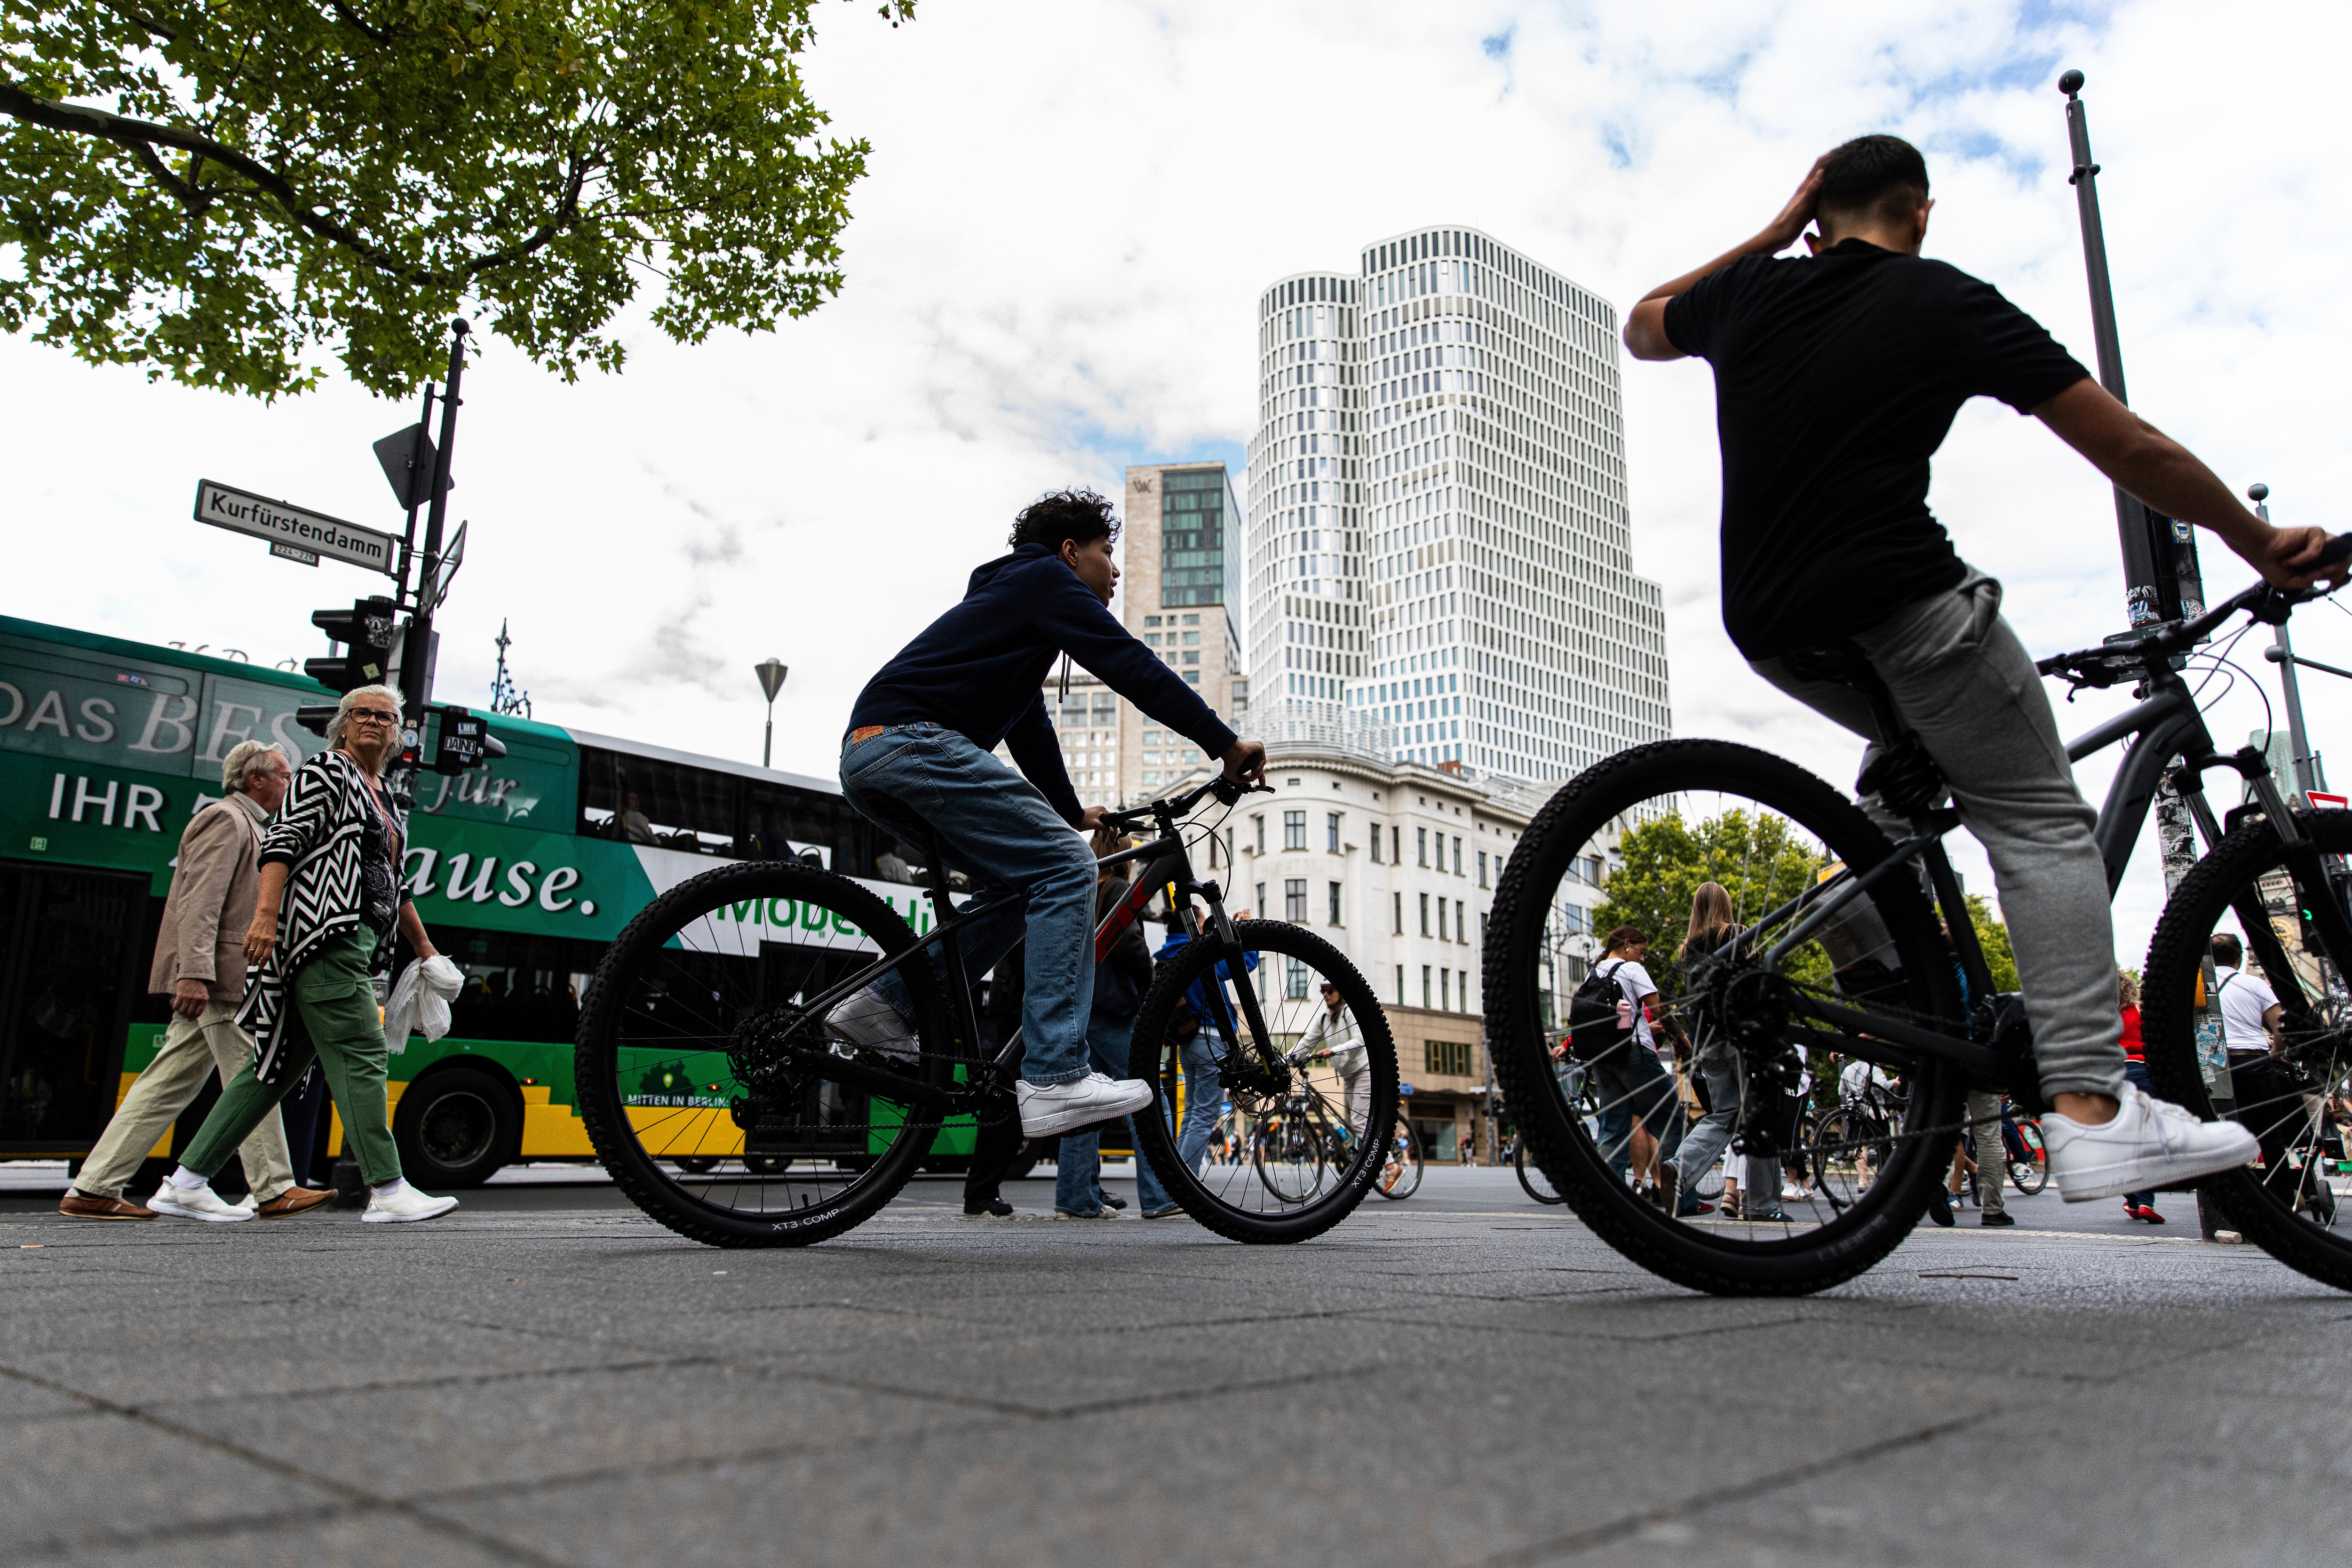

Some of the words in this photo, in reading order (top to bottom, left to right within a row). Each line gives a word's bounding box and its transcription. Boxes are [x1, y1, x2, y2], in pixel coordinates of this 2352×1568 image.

[211, 492, 382, 558] Kurfürstendamm
[0, 682, 115, 743] DAS
[127, 691, 303, 773] BES
[49, 773, 164, 832] IHR
[404, 846, 595, 916] ause.
[628, 1094, 668, 1106] MITTEN
[672, 1095, 684, 1106] IN
[1351, 1170, 1367, 1188] XT3
[1365, 1139, 1380, 1167] COMP
[772, 1221, 798, 1230] XT3
[803, 1209, 839, 1225] COMP
